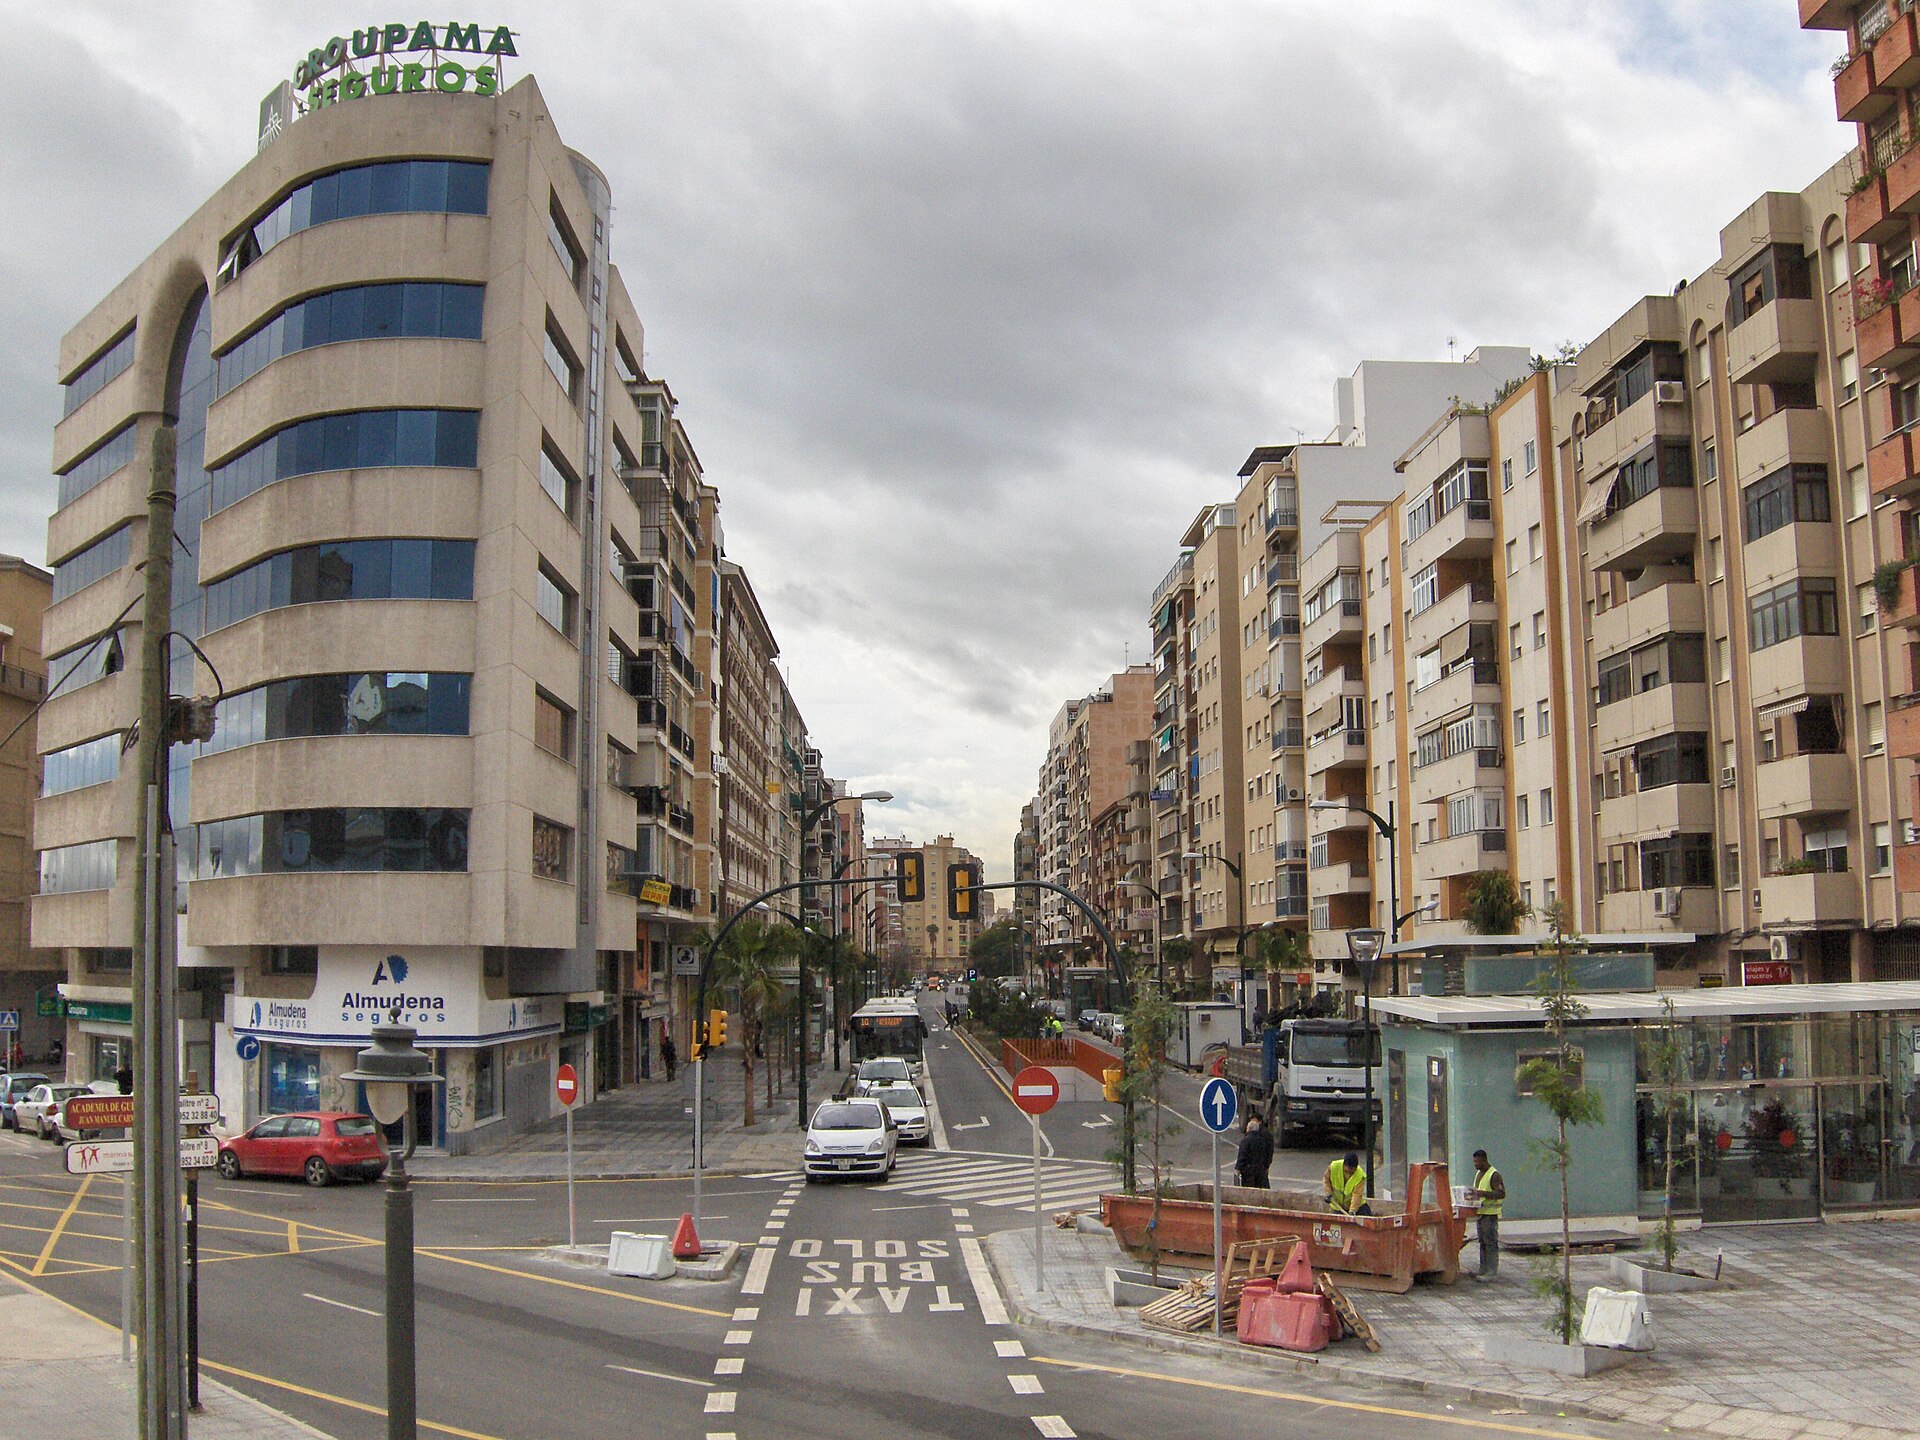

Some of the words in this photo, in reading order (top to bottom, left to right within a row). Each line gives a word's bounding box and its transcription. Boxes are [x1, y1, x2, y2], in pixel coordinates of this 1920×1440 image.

[293, 21, 518, 90] GROUPAMA
[307, 62, 499, 112] SEGUROS
[342, 992, 445, 1009] Almudena
[269, 1002, 307, 1019] Almudena
[268, 1017, 307, 1030] seguros
[71, 1103, 109, 1113] ACADEMIA
[110, 1102, 119, 1112] DE
[205, 1098, 209, 1107] 2
[79, 1115, 93, 1124] JUAN
[94, 1114, 118, 1124] MANUEL
[191, 1111, 199, 1120] 32
[209, 1110, 218, 1119] 40
[202, 1155, 209, 1165] 02
[789, 1238, 950, 1258] SOLO
[802, 1261, 936, 1284] BUS
[795, 1285, 965, 1316] TAXI
